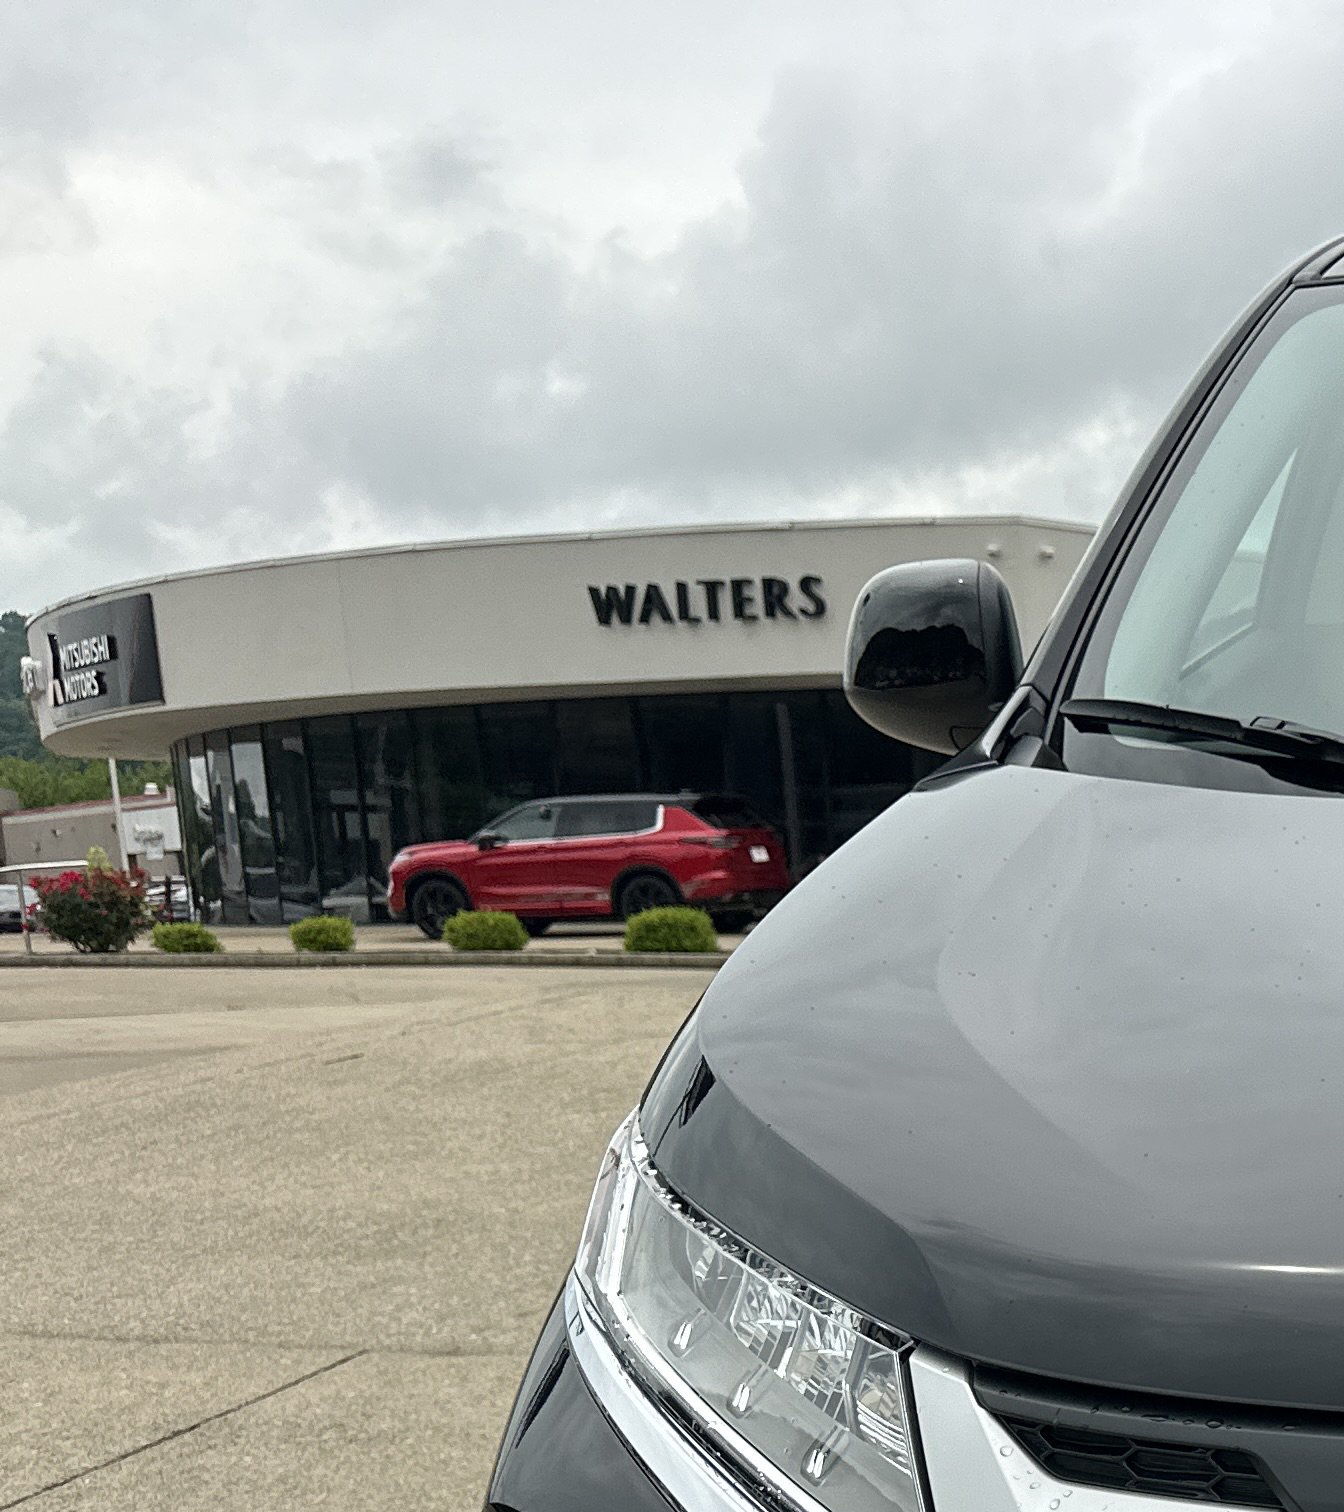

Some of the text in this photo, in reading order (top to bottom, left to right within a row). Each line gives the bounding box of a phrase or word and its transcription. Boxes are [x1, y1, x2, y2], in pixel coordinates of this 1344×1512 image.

[587, 576, 827, 627] WALTERS
[59, 634, 110, 671] MITSUBISHI
[63, 669, 99, 703] MOTORS
